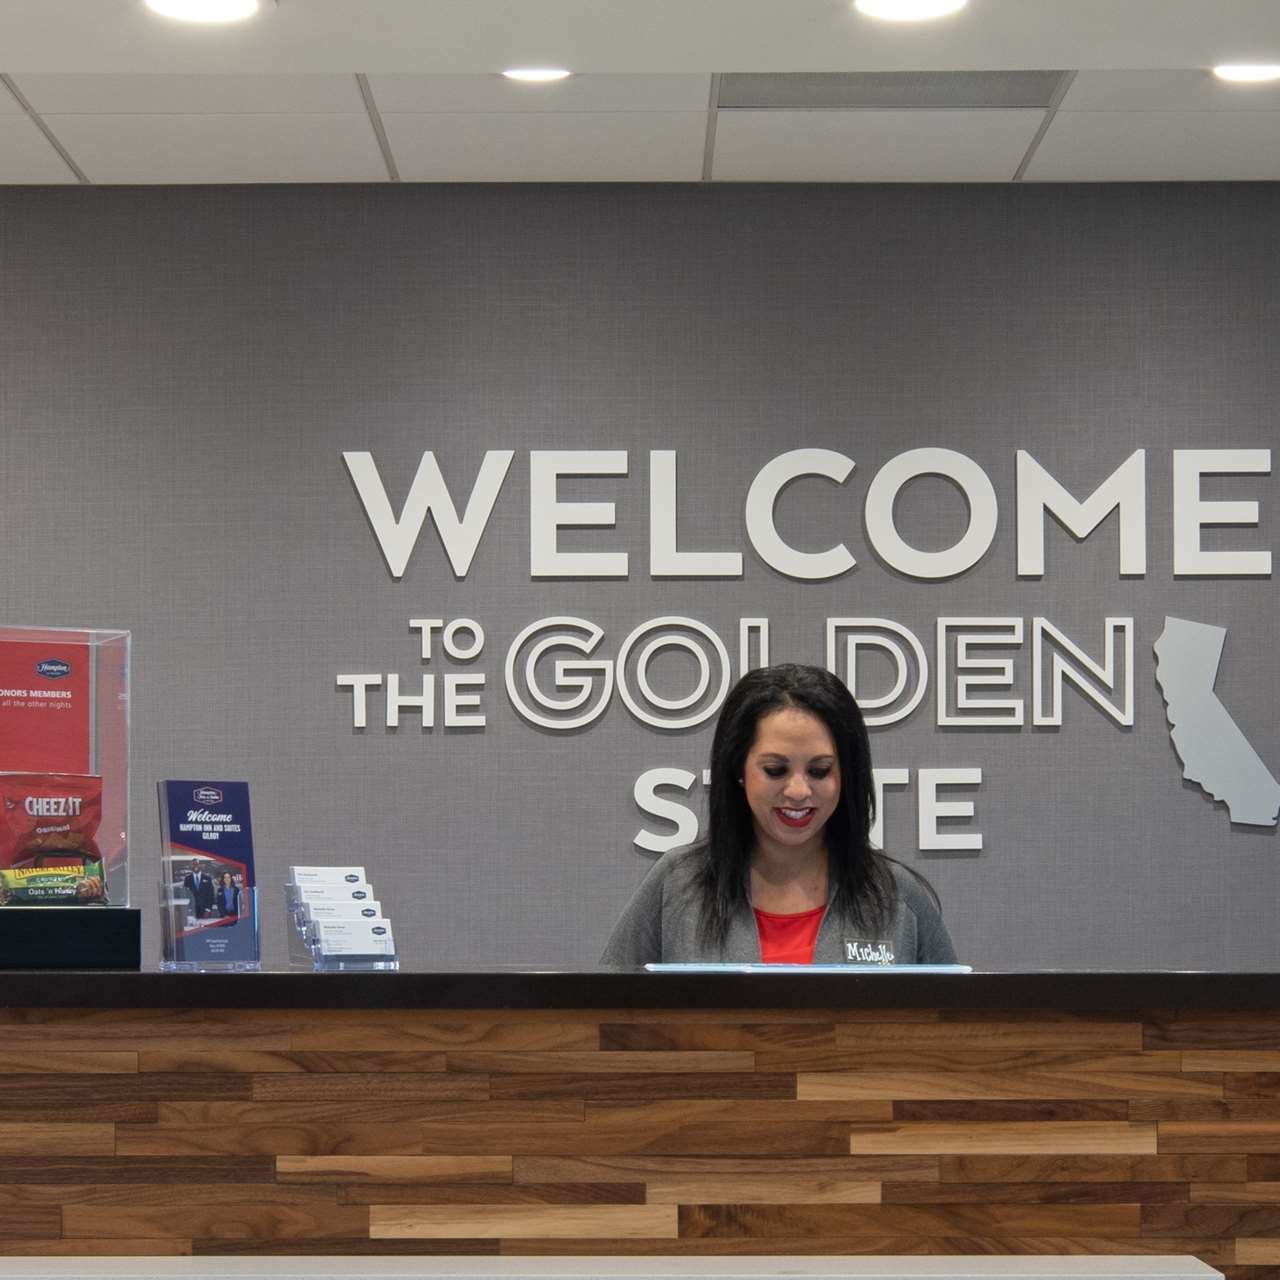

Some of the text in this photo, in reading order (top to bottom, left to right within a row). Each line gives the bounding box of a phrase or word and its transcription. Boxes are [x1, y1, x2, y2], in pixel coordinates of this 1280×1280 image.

[342, 447, 1272, 580] WELCOME
[409, 618, 485, 661] TO
[29, 690, 73, 699] MEMBERS
[336, 672, 487, 730] THE
[186, 808, 233, 823] Welcome
[632, 767, 984, 853] STE
